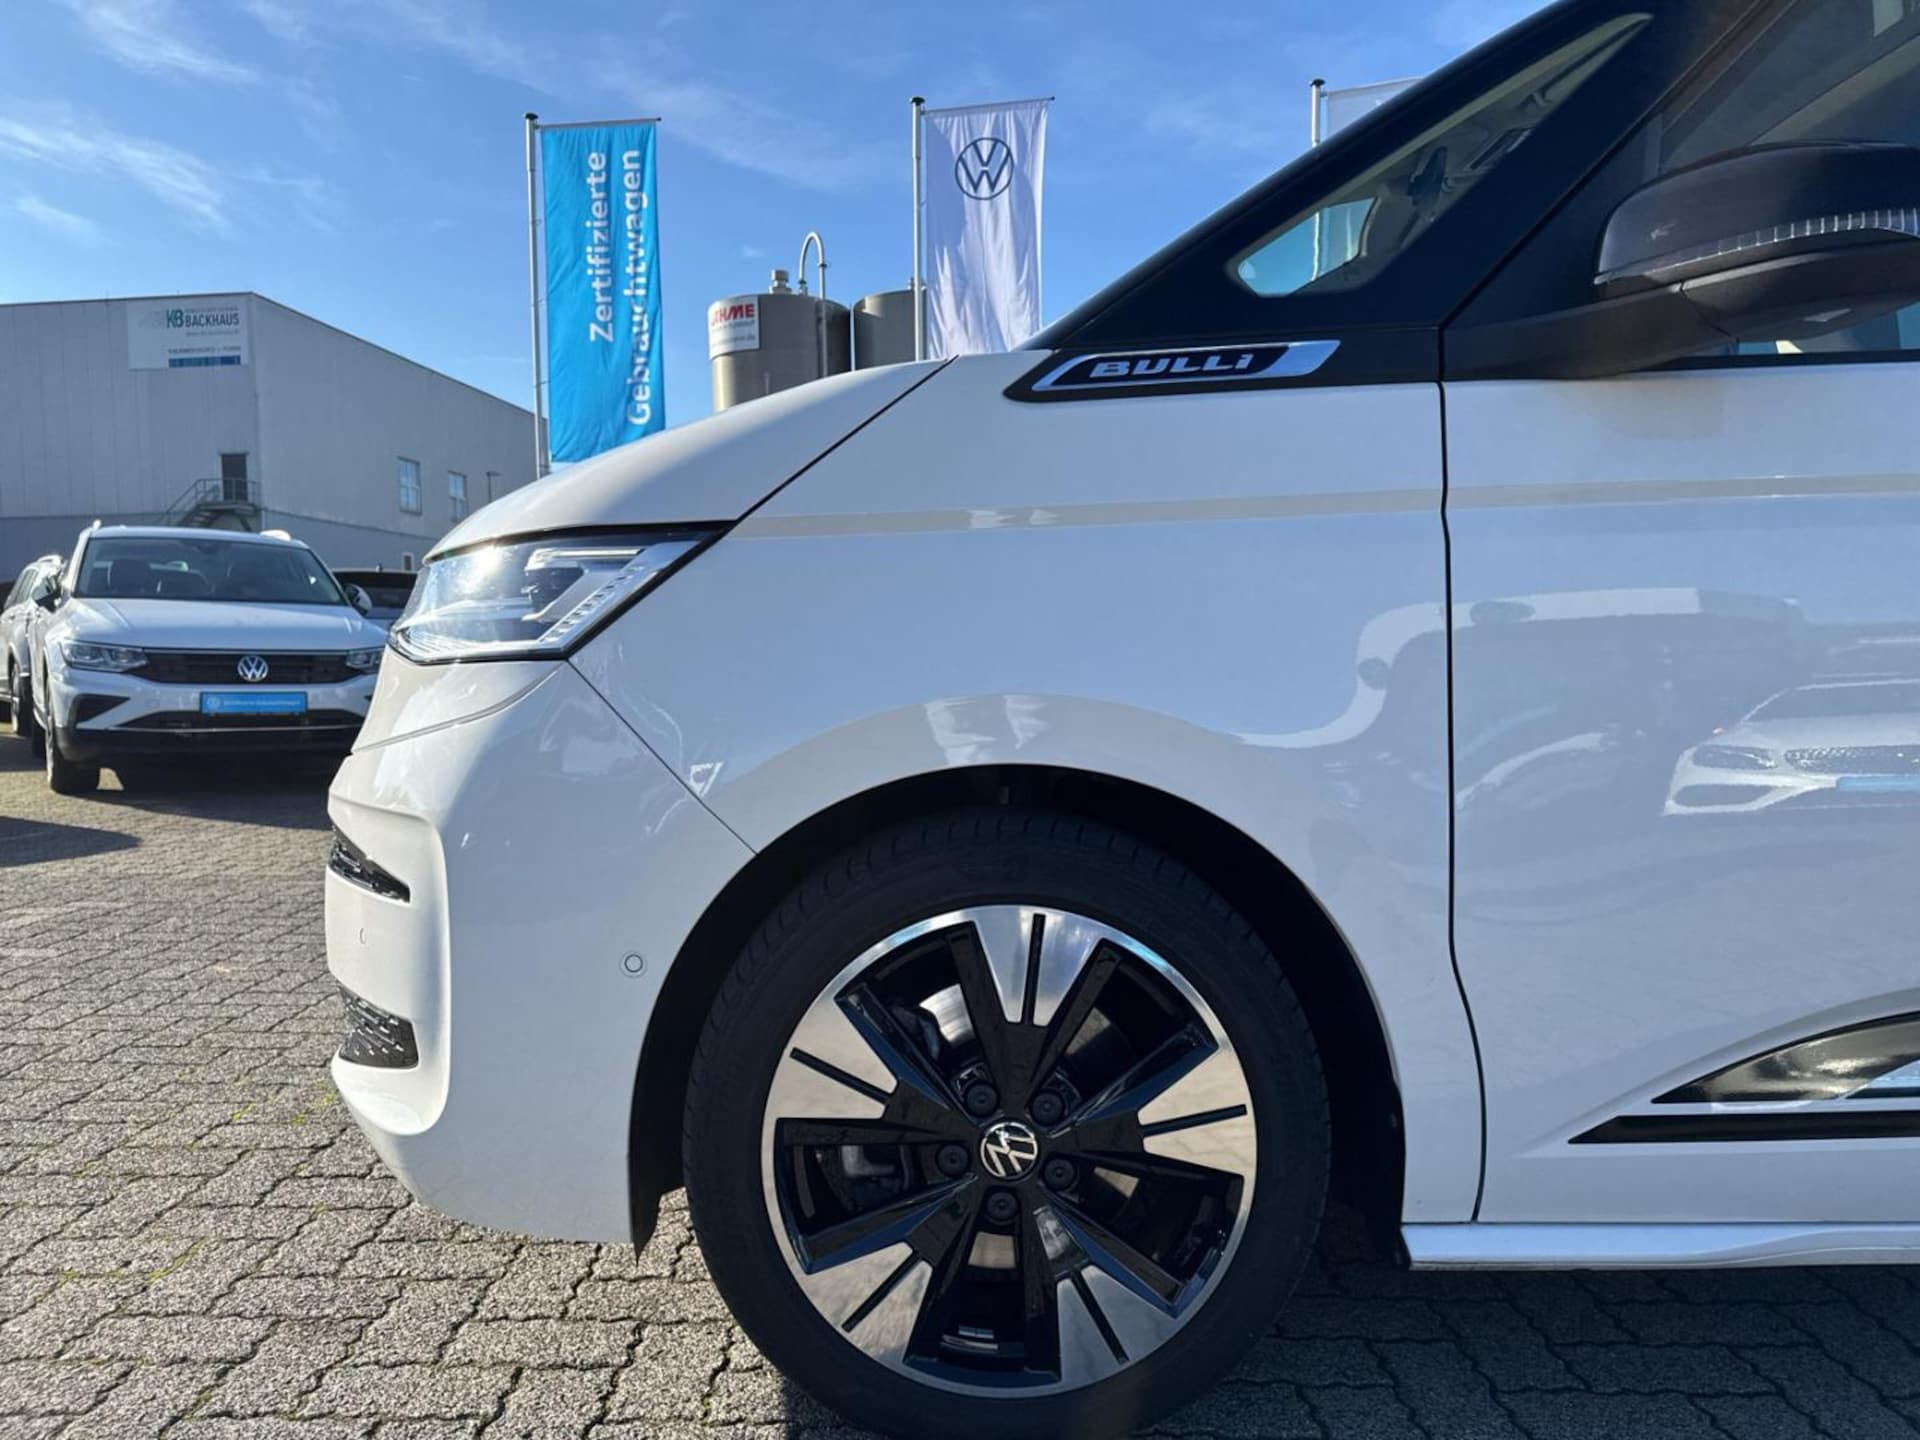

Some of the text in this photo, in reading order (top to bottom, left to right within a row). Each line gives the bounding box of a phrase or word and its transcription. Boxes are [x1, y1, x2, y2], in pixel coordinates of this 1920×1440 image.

[955, 137, 1014, 200] VW
[585, 151, 614, 342] Zertifizierte
[185, 312, 240, 328] BACKHAUS
